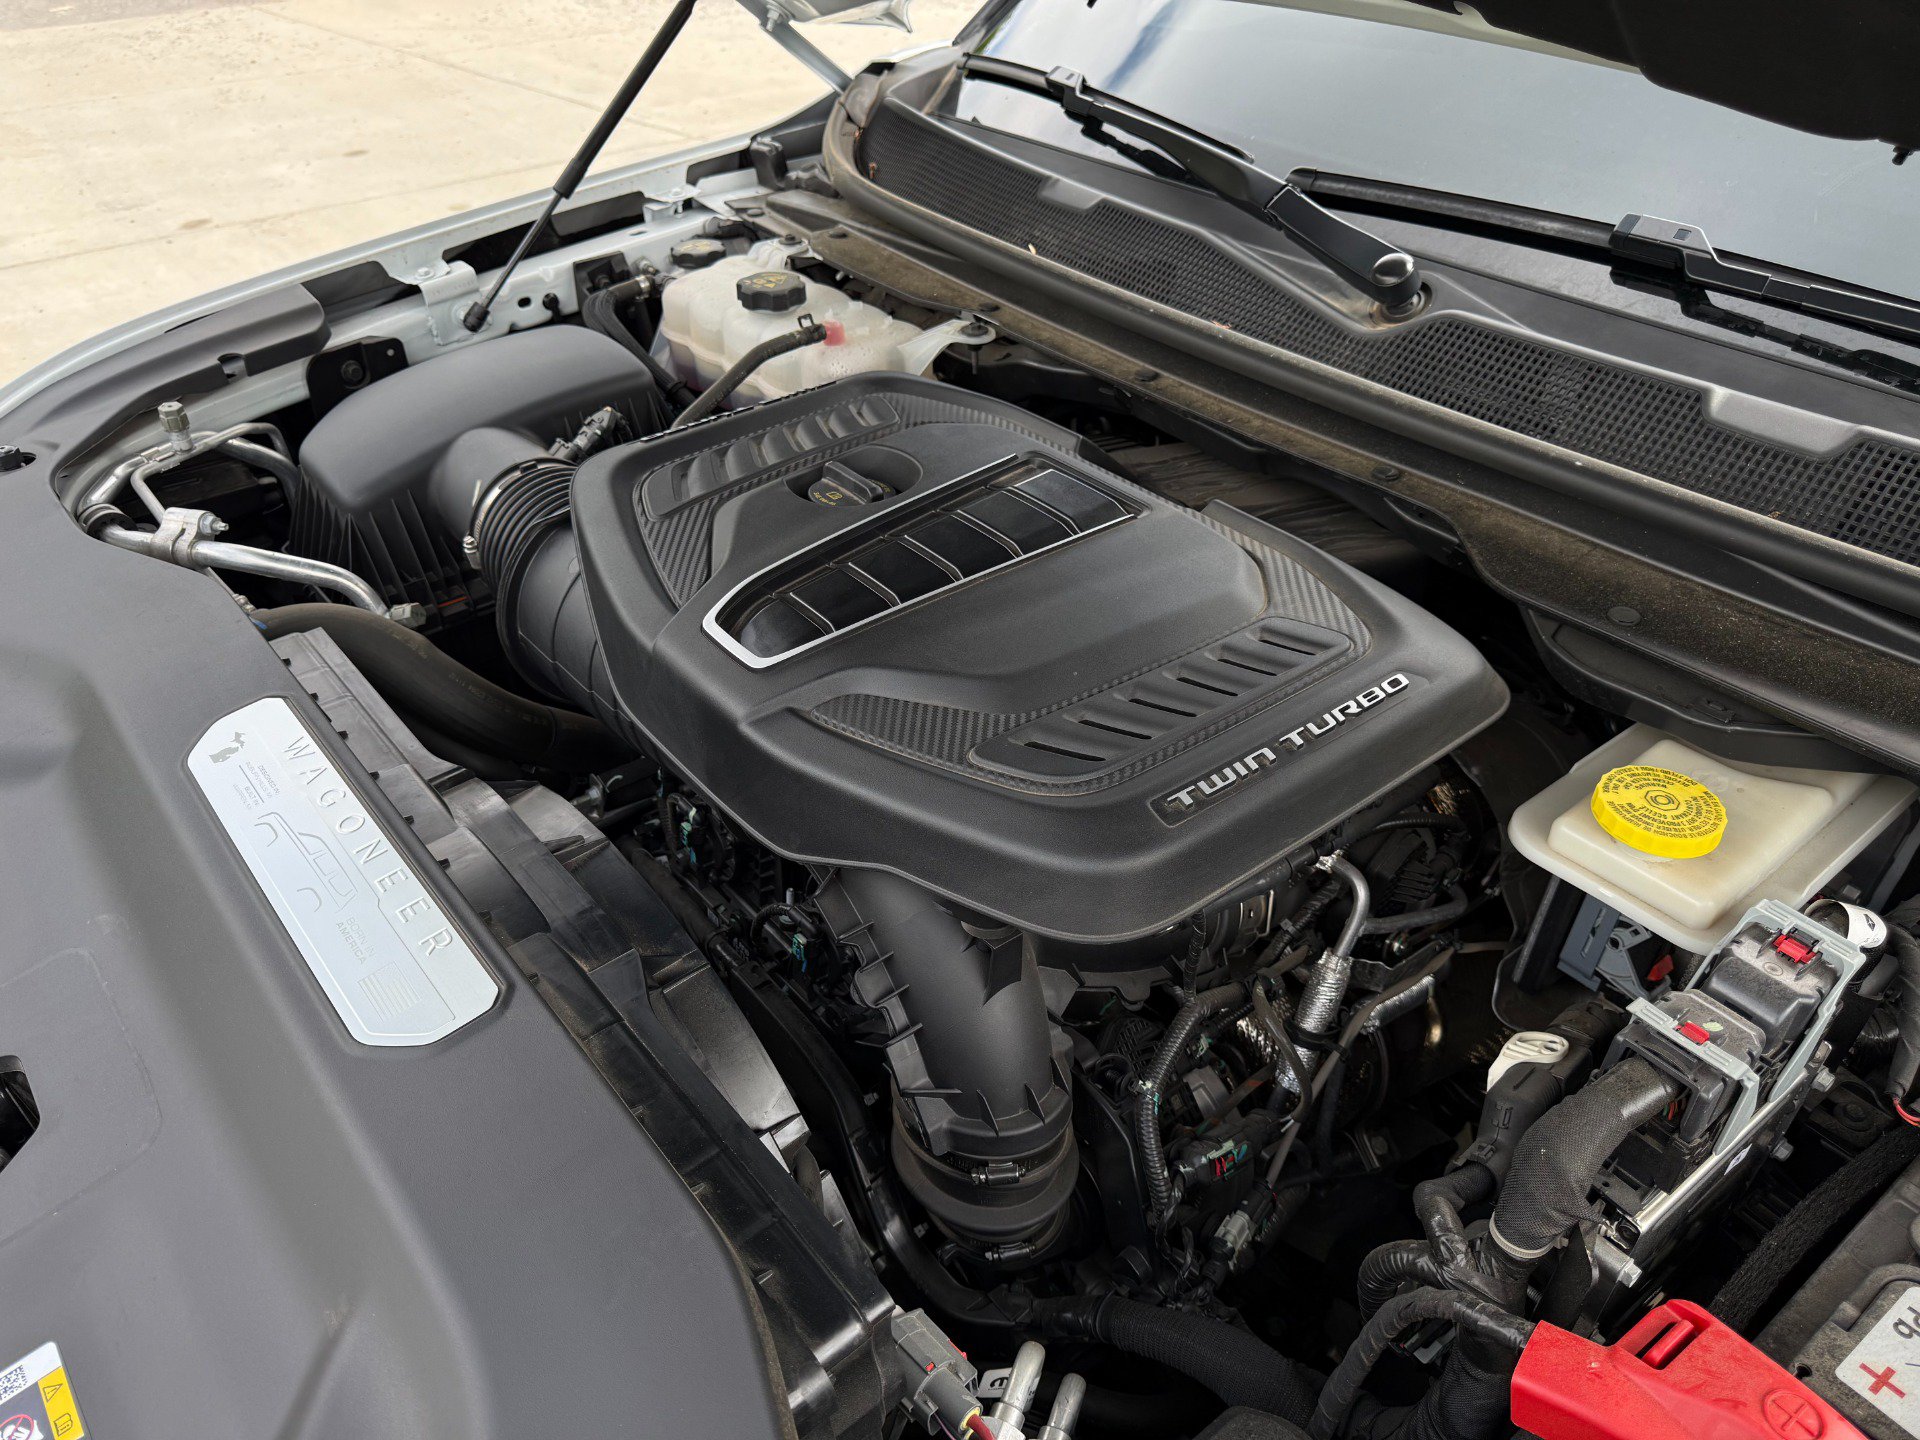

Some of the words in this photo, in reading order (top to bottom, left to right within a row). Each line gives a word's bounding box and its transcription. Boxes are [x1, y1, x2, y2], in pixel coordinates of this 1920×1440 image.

[1166, 747, 1277, 807] TWIN
[1278, 673, 1411, 749] TURBO
[282, 736, 453, 957] WAGONEER
[335, 920, 368, 965] AMERICA
